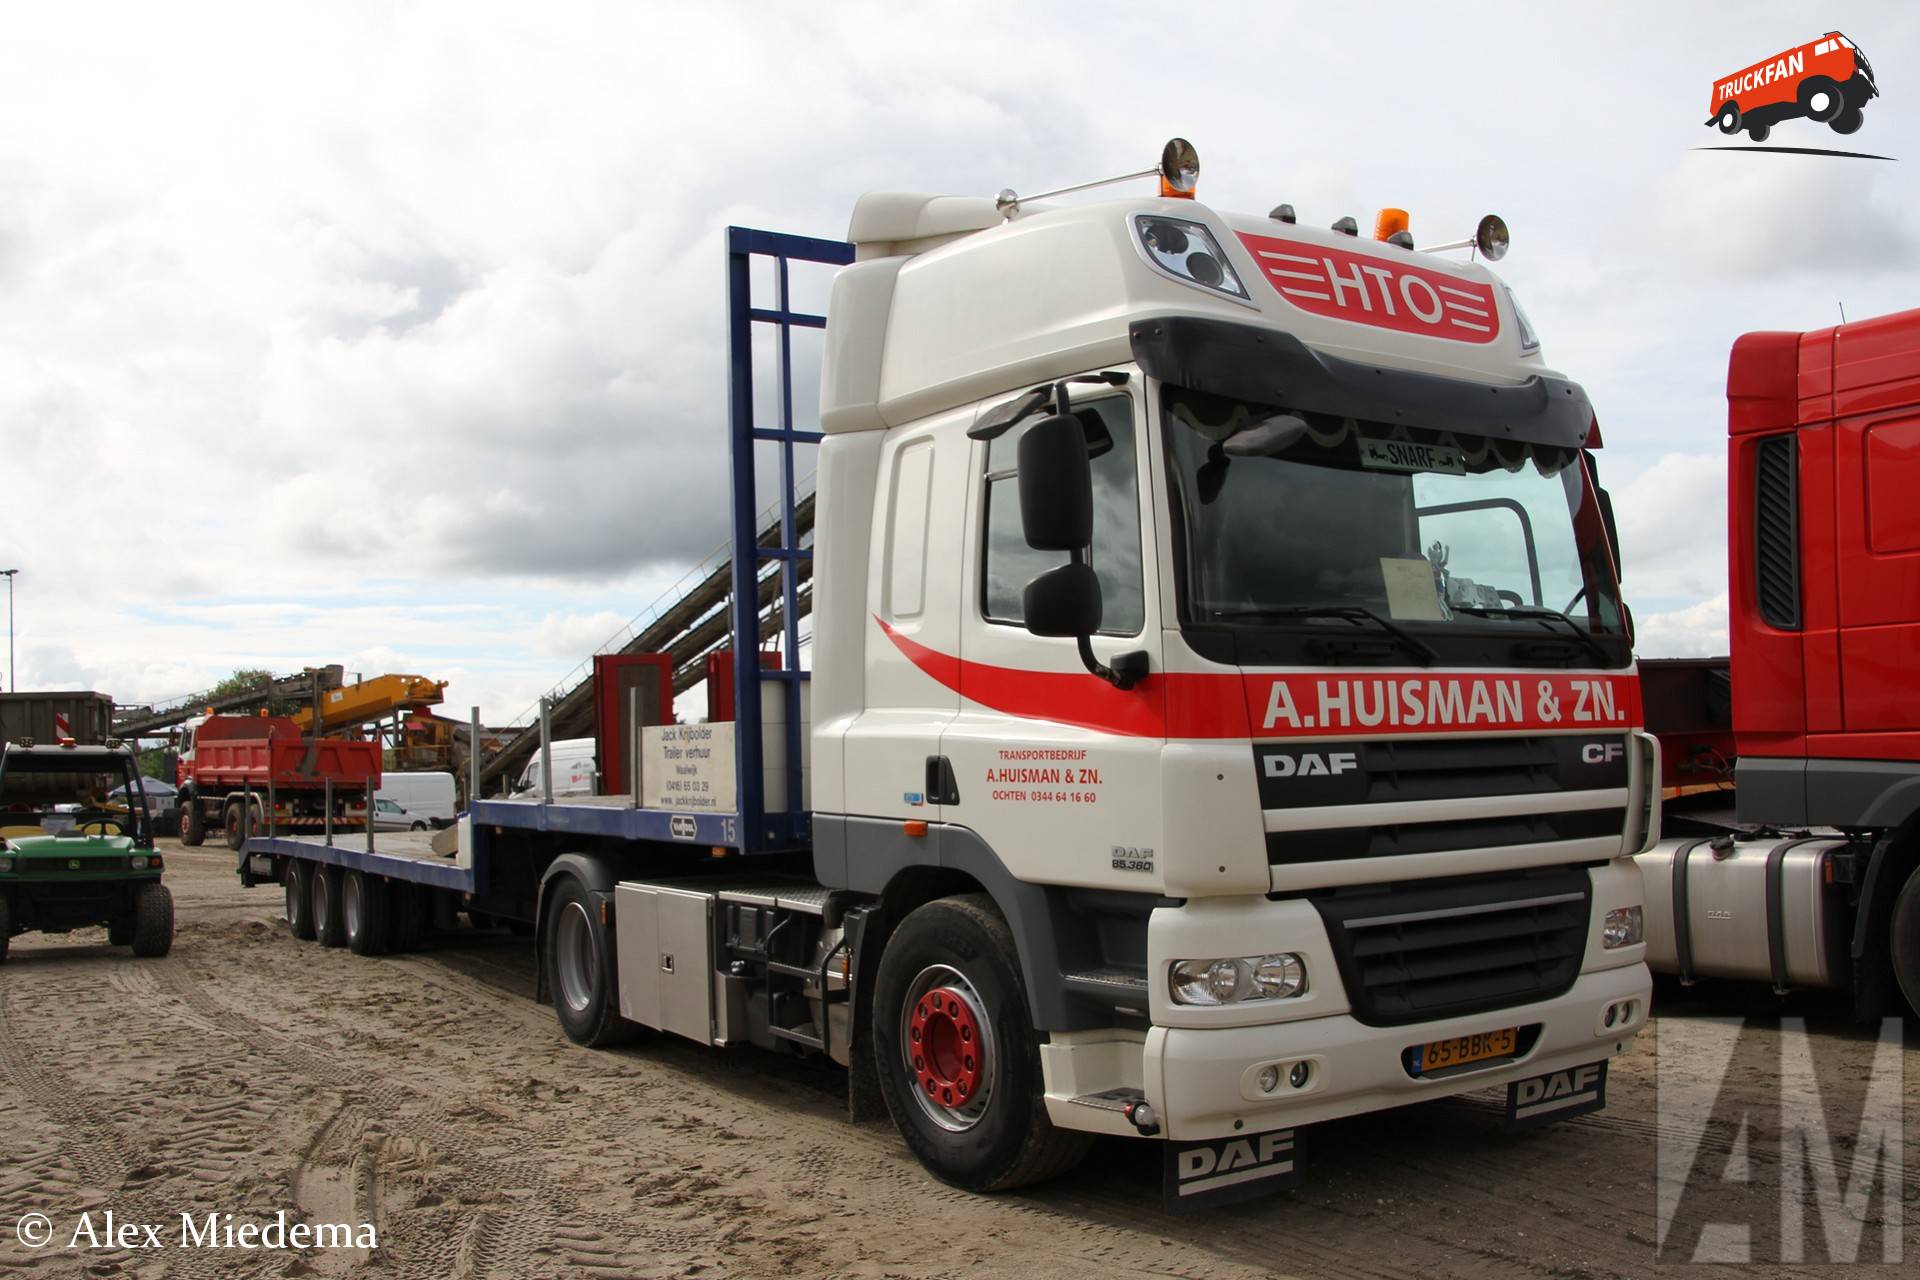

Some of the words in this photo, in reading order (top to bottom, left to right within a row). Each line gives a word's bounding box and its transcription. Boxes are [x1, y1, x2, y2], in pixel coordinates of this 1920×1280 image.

[1323, 257, 1443, 323] HTO
[1387, 443, 1435, 468] SNARF
[1262, 680, 1523, 729] A.HUISMAN
[1536, 680, 1560, 722] &
[1573, 680, 1625, 721] ZN.
[661, 729, 676, 741] Jack
[664, 746, 682, 759] Trailer
[685, 745, 711, 759] verhuur
[1000, 750, 1087, 760] TRANSPORTBEDRIJF
[1582, 743, 1623, 764] CF
[987, 768, 1060, 783] A.HUISMAN
[1065, 768, 1075, 783] &
[1079, 769, 1103, 784] ZN.
[1263, 753, 1357, 777] DAF
[993, 791, 1026, 801] OCHTEN
[1031, 791, 1053, 802] 0344
[1055, 792, 1067, 802] 64
[1070, 792, 1081, 802] 16
[1084, 792, 1096, 803] 60
[720, 818, 736, 842] 15
[1112, 846, 1154, 859] DAF
[1428, 1029, 1511, 1065] 65-BBK-5
[1516, 1067, 1599, 1107] DAF
[1179, 1130, 1294, 1180] DAF
